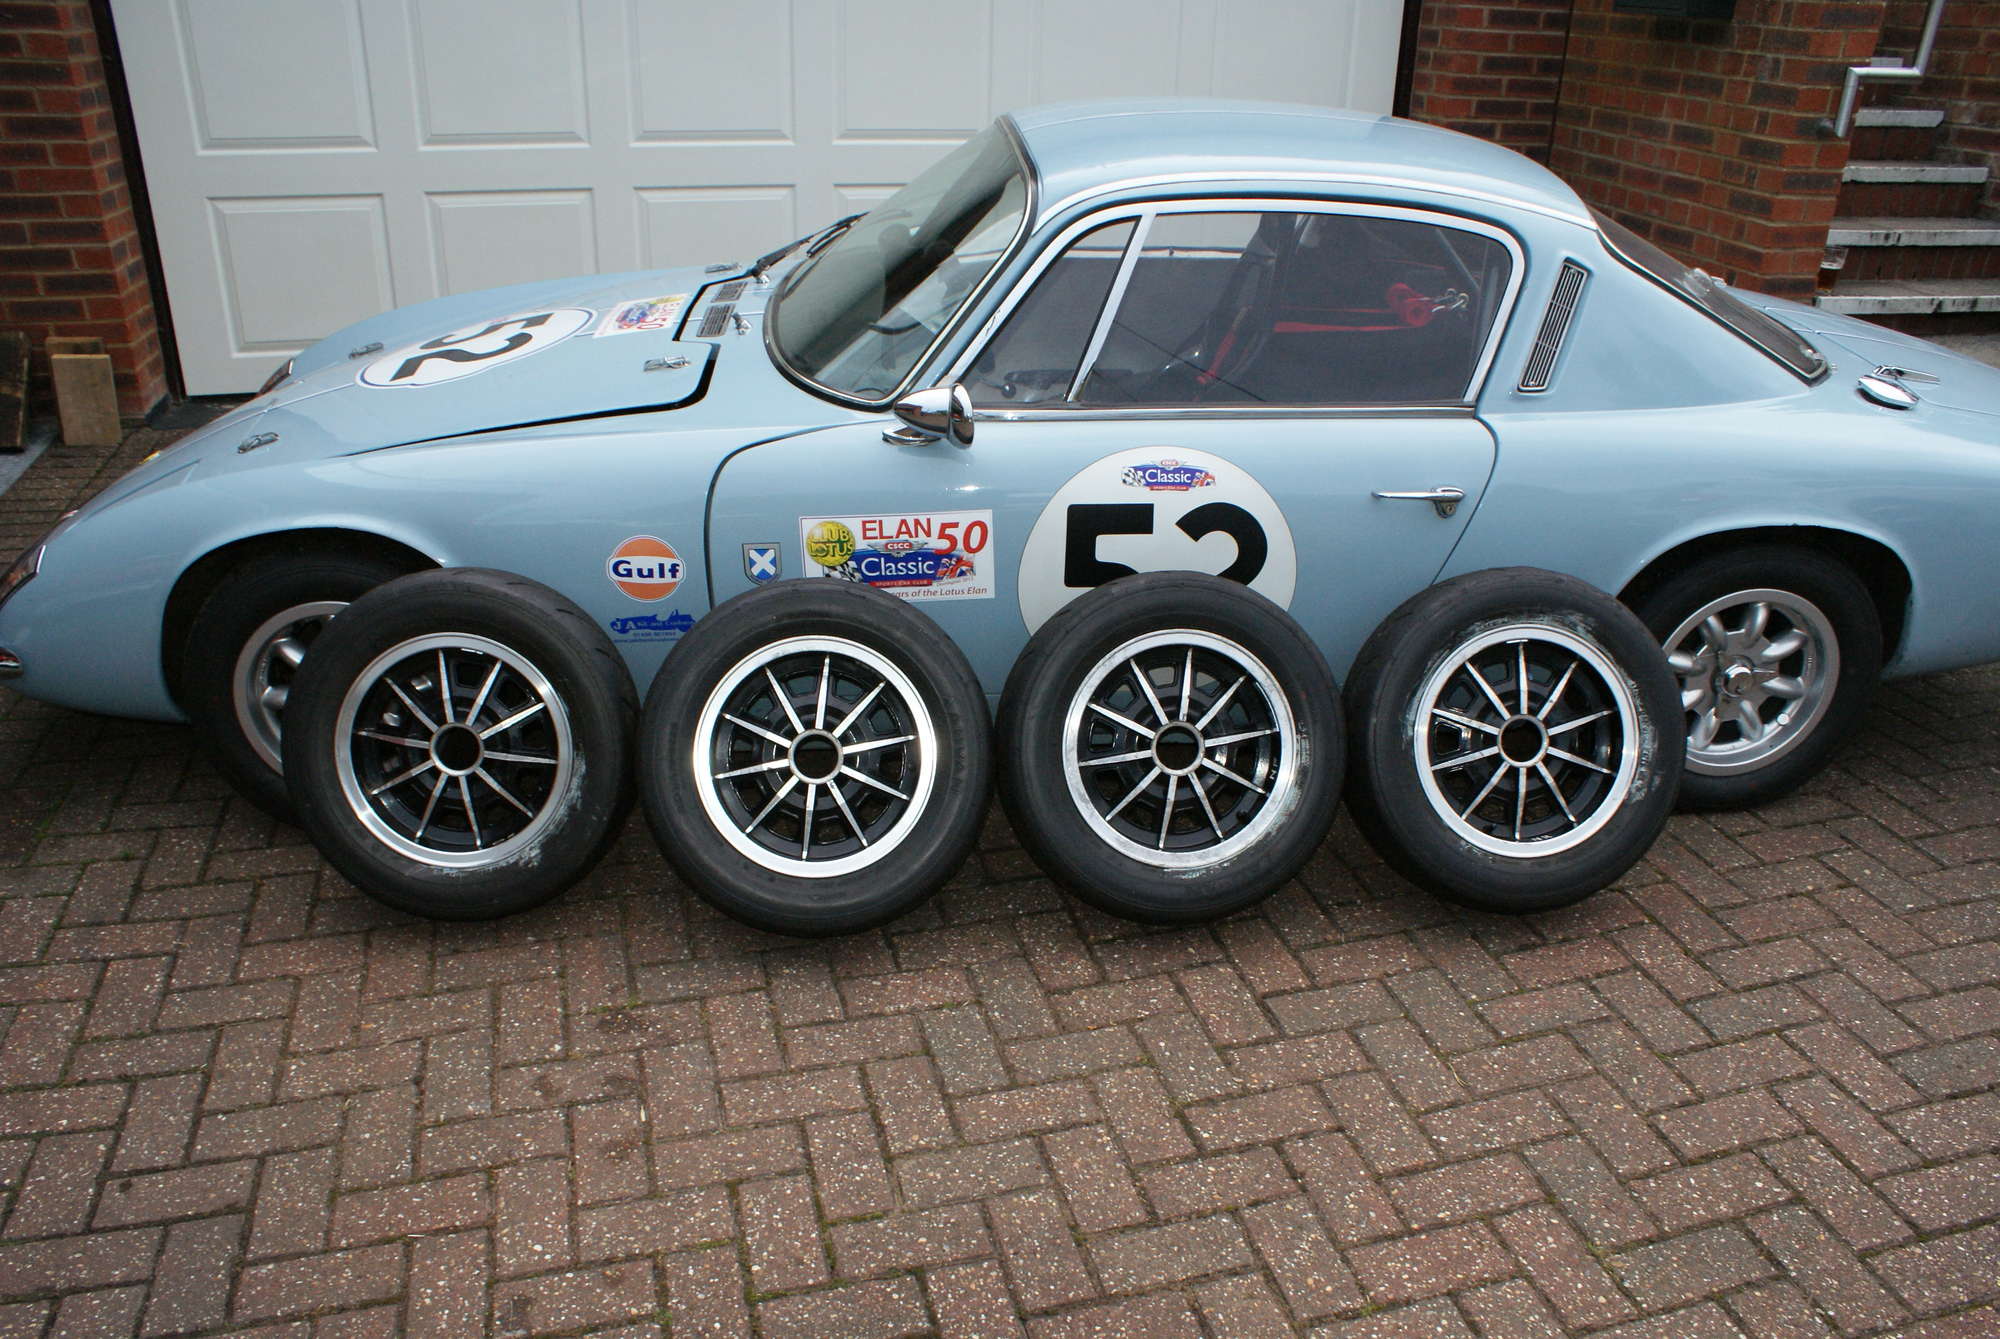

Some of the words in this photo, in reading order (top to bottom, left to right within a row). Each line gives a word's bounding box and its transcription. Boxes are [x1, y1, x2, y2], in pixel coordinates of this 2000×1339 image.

[389, 313, 554, 382] 52
[1145, 469, 1191, 483] Classic
[861, 518, 932, 541] ELAN
[933, 520, 989, 555] 50
[808, 542, 853, 557] LOTUS
[887, 542, 910, 550] CSCC
[612, 559, 681, 579] Gulf
[861, 557, 935, 576] Classic
[892, 590, 909, 598] ars
[911, 588, 921, 598] of
[923, 588, 938, 597] the
[940, 587, 965, 597] Lotus
[967, 586, 988, 595] Elan
